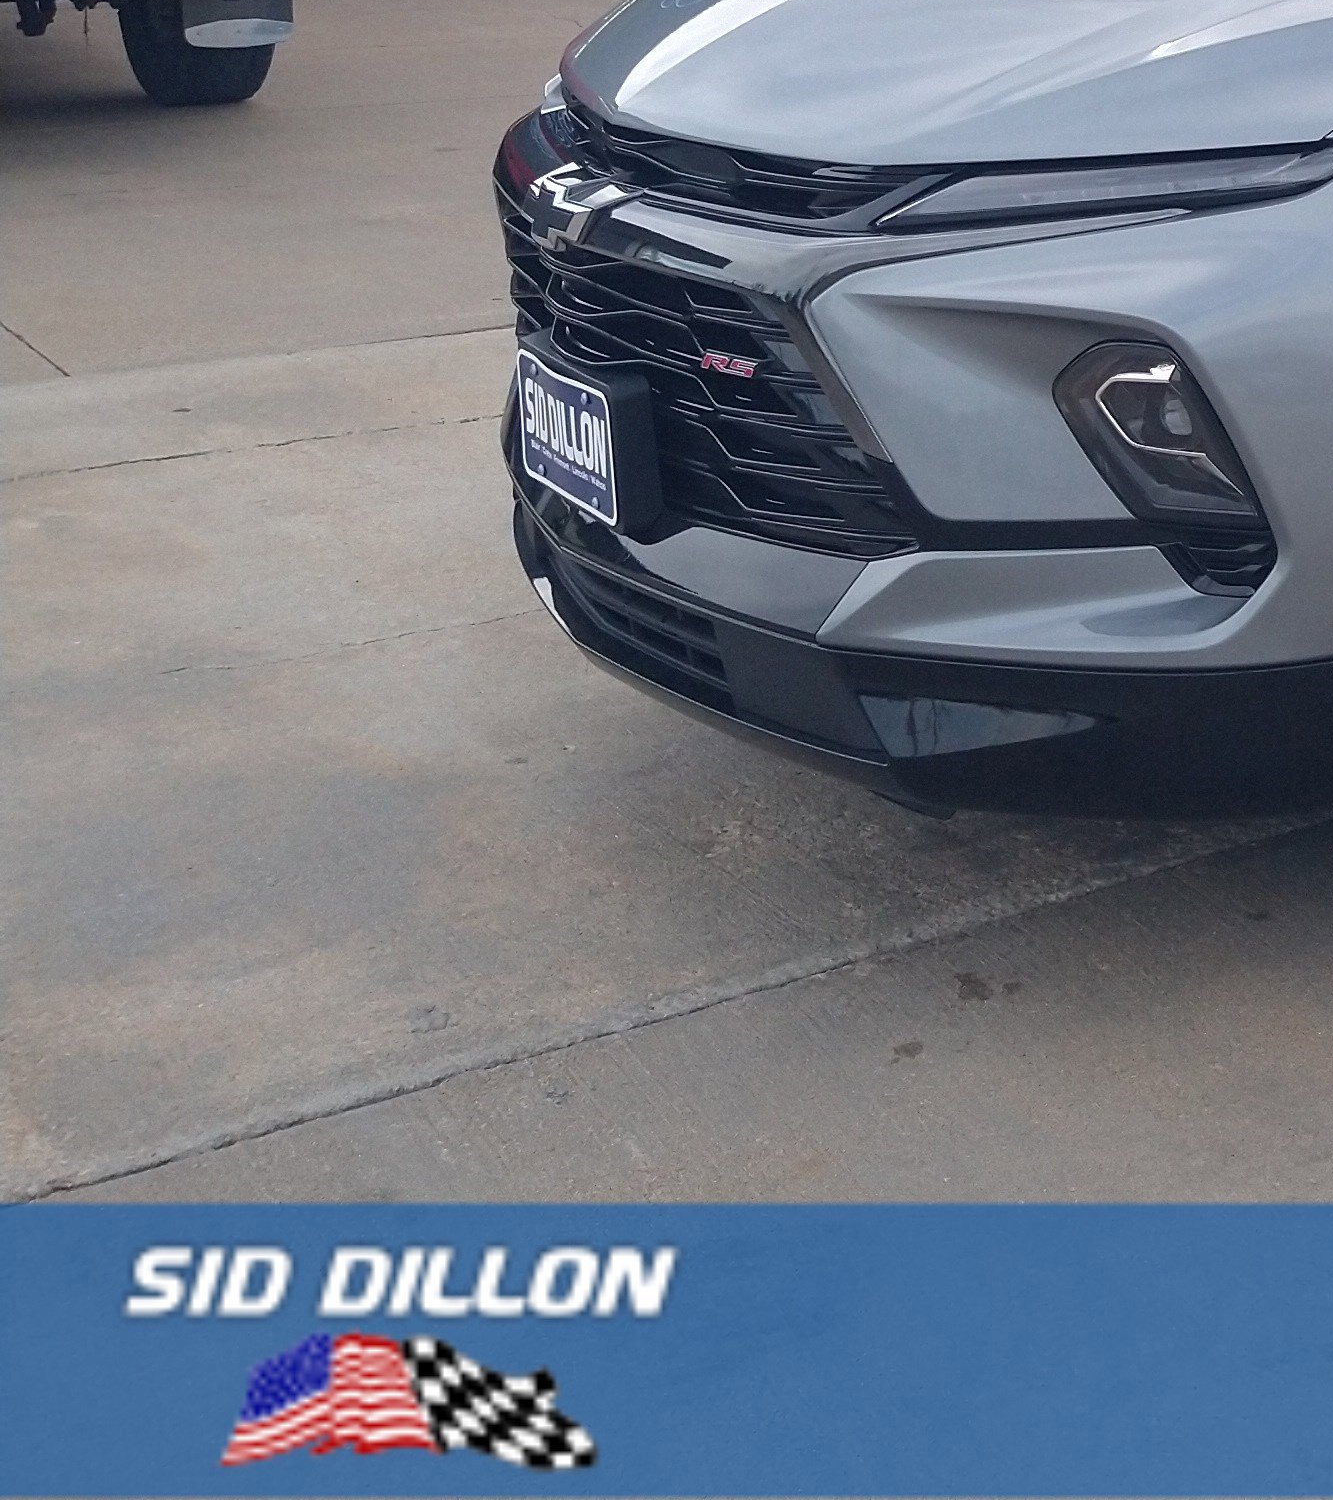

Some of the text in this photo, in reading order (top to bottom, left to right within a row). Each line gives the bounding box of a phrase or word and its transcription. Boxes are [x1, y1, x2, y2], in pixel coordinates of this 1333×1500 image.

[701, 352, 758, 378] RS
[525, 377, 607, 479] SID DILLON
